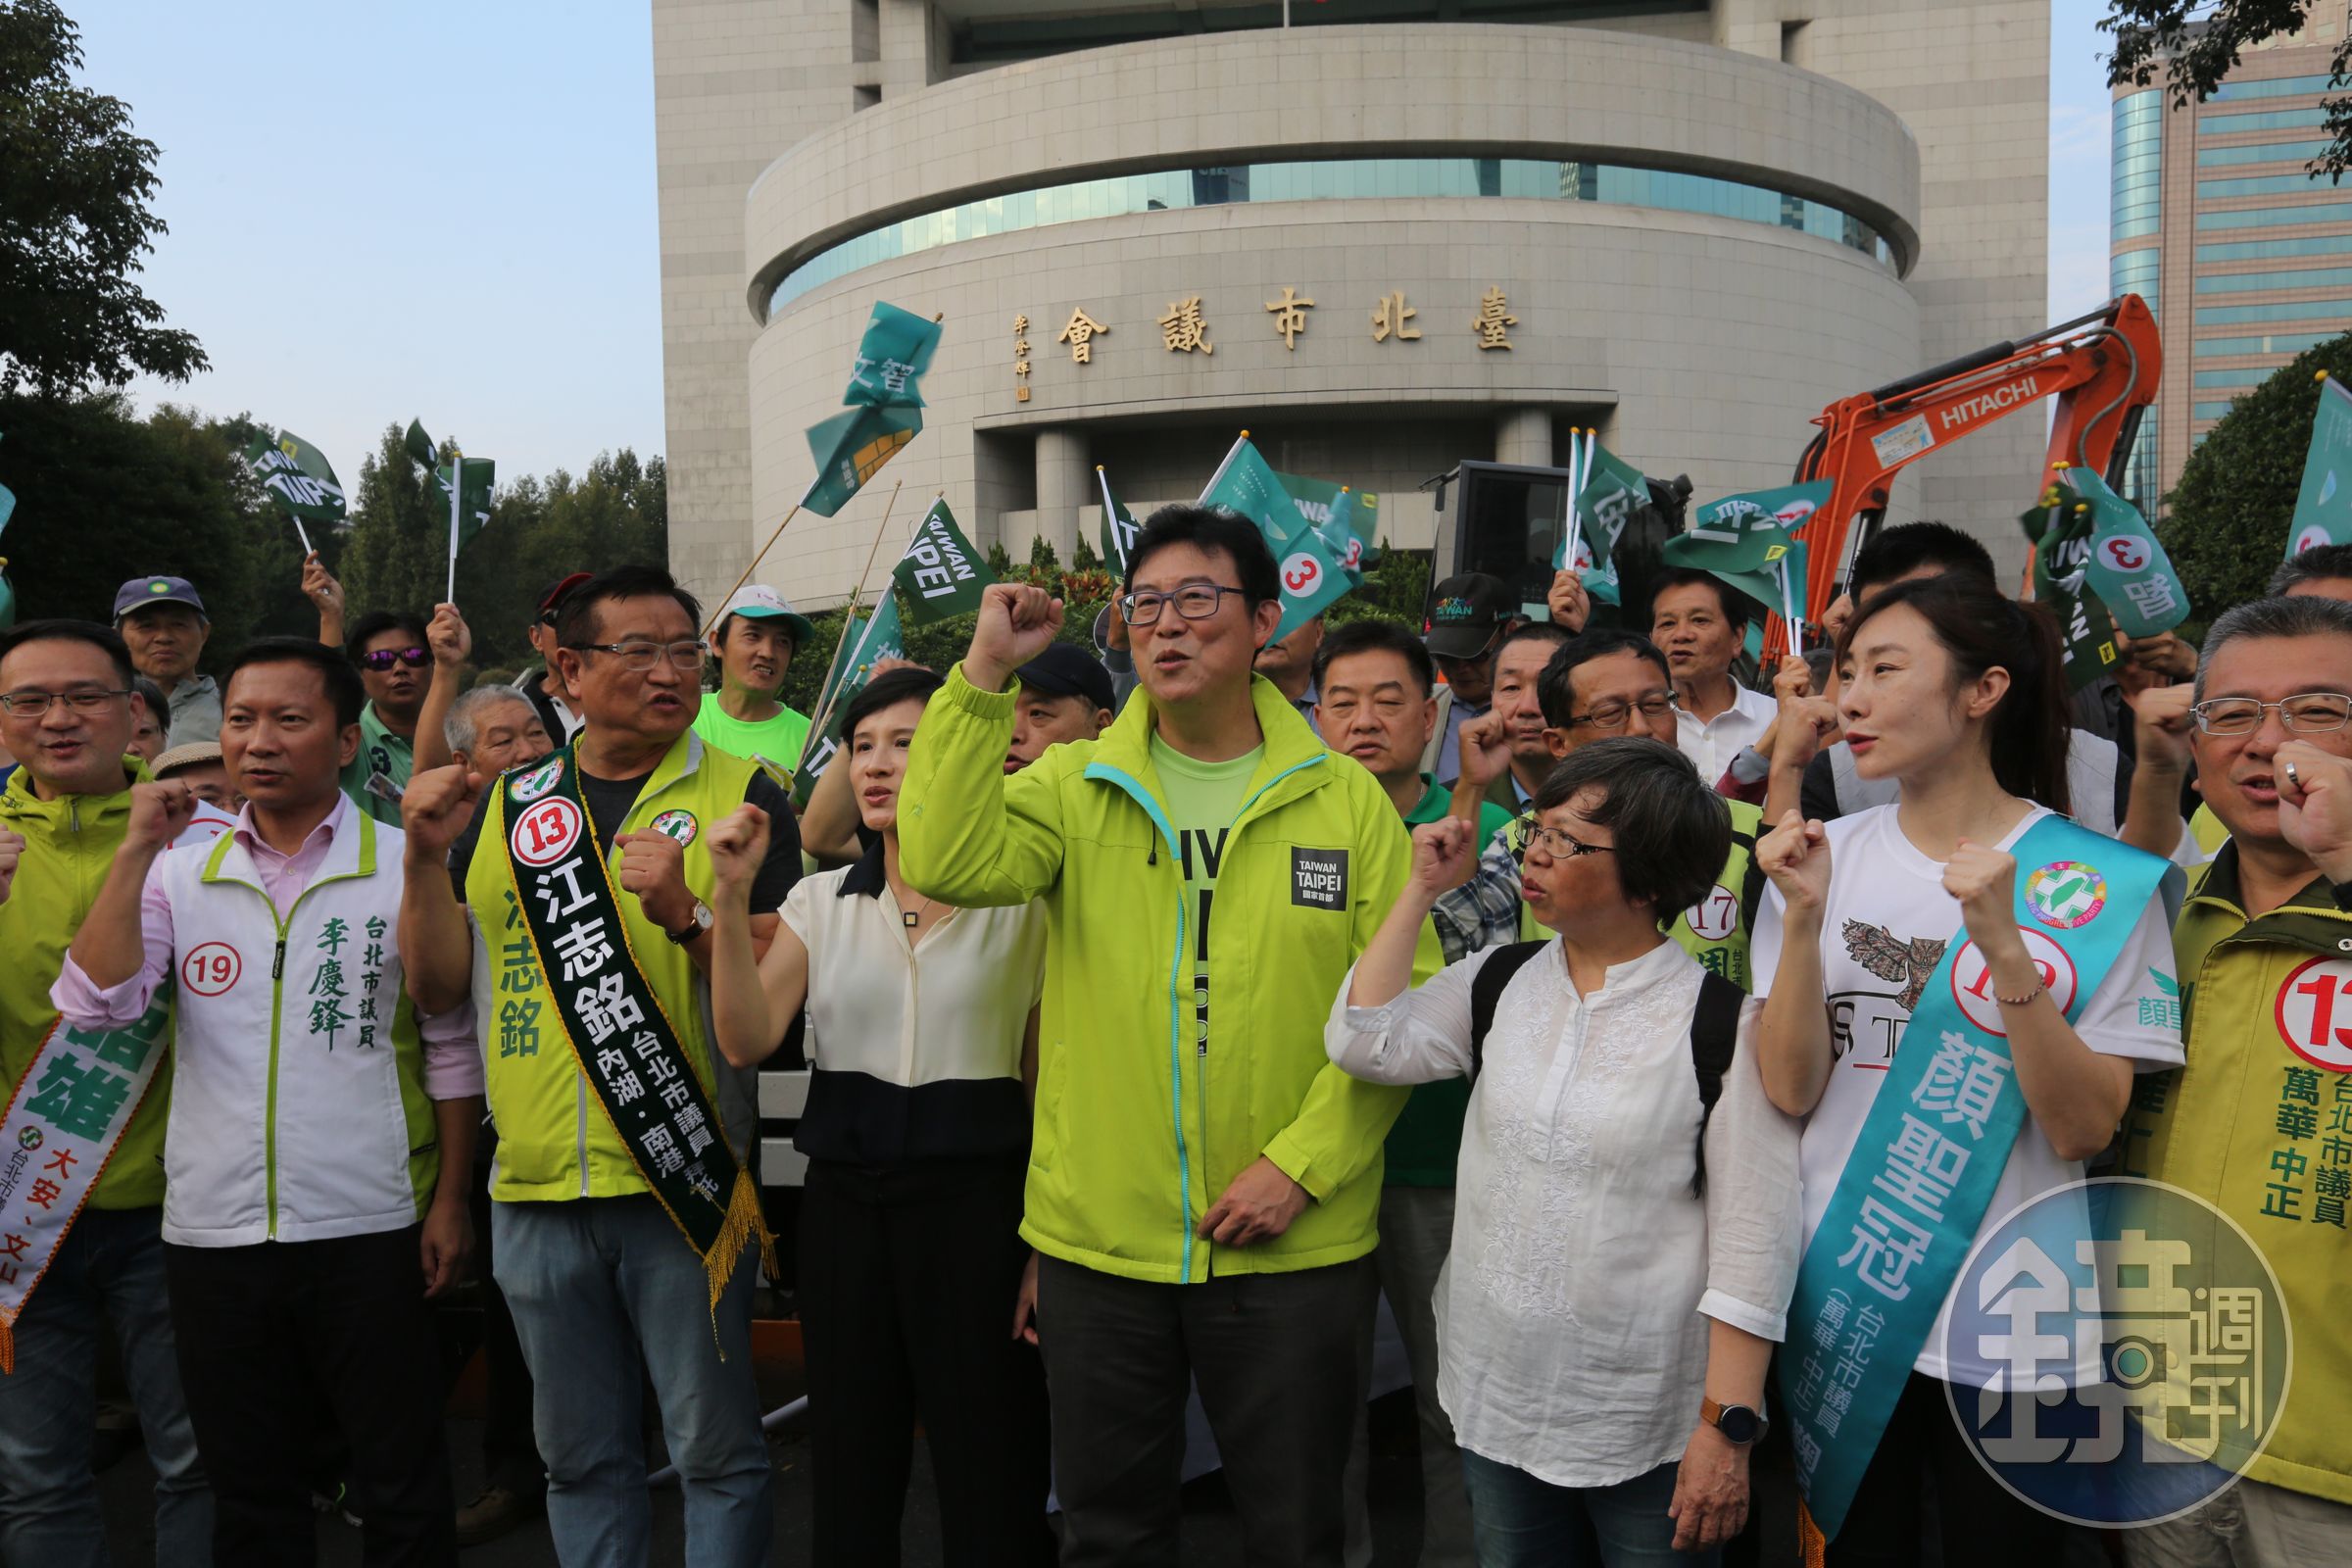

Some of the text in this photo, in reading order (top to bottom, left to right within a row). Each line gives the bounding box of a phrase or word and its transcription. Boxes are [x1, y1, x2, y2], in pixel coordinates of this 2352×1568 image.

[1940, 376, 2038, 429] HITACHI
[926, 513, 976, 581] TAIWAN
[1285, 560, 1317, 591] 3
[526, 807, 567, 854] 13
[1296, 871, 1342, 892] TAIPEI
[1298, 859, 1337, 873] TAIWAN
[1693, 896, 1734, 930] 17
[192, 956, 231, 983] 19
[536, 856, 645, 1047] 江志銘
[308, 917, 356, 1053] 李慶鋒
[357, 915, 388, 1049] 台北市議員
[631, 1030, 714, 1158] 台北市議員
[1838, 1030, 2013, 1301] 顏聖冠
[1814, 1304, 1886, 1440] 台北市議員
